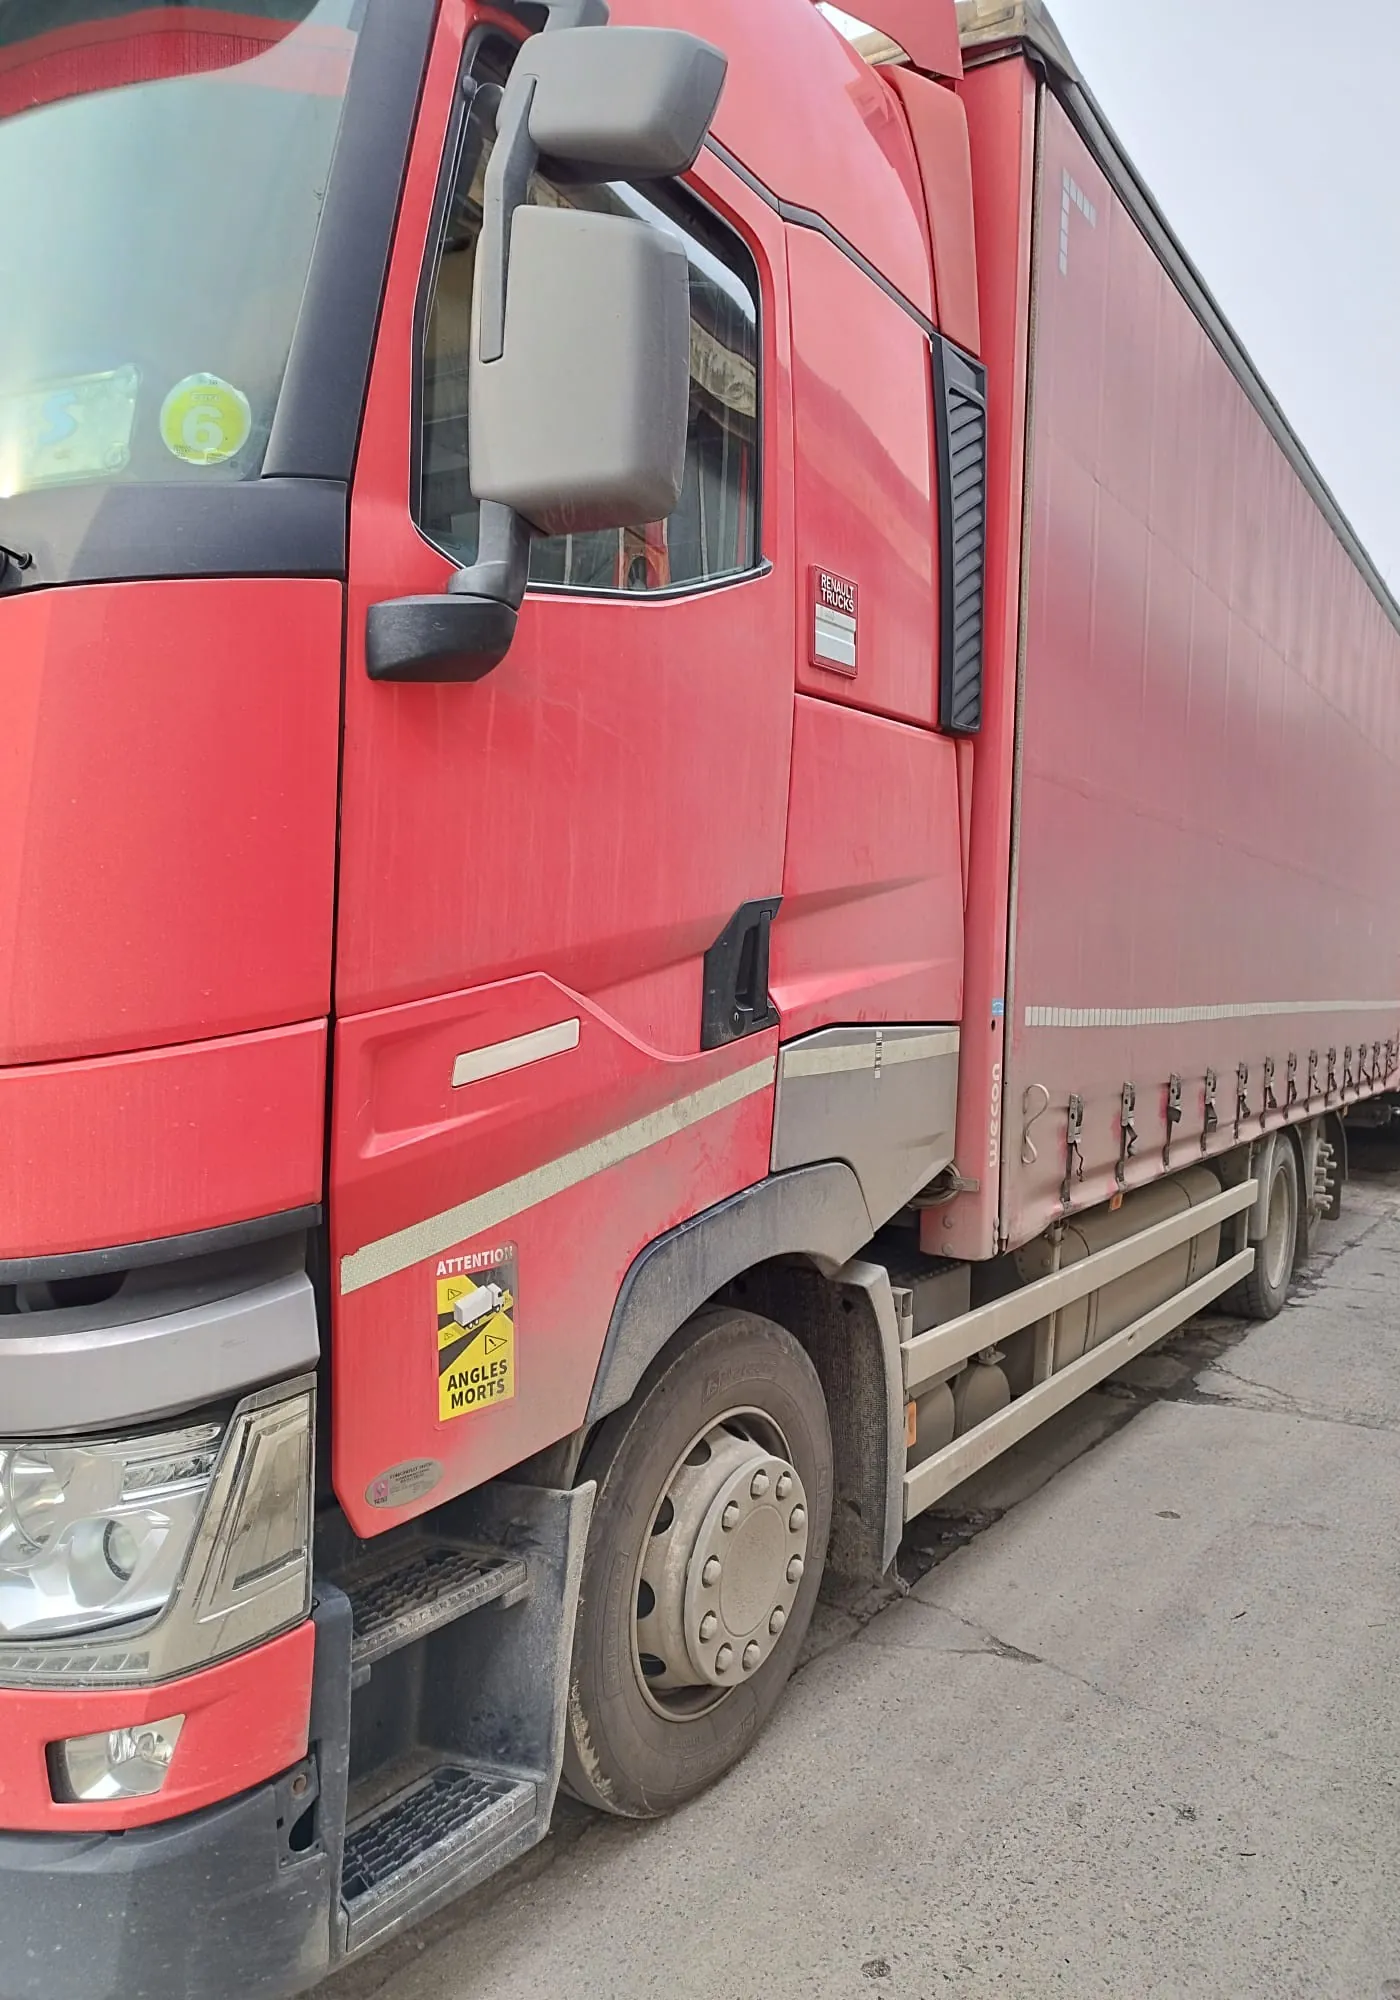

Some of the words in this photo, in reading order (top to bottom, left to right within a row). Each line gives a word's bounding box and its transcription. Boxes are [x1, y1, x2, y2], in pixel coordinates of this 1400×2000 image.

[182, 405, 223, 453] 6
[821, 573, 854, 599] RENAULT
[821, 587, 854, 612] TRUCKS
[988, 1063, 1000, 1167] wecon
[436, 1245, 513, 1277] ATTENTION
[447, 1359, 508, 1392] ANGLES
[451, 1378, 505, 1409] MORTS
